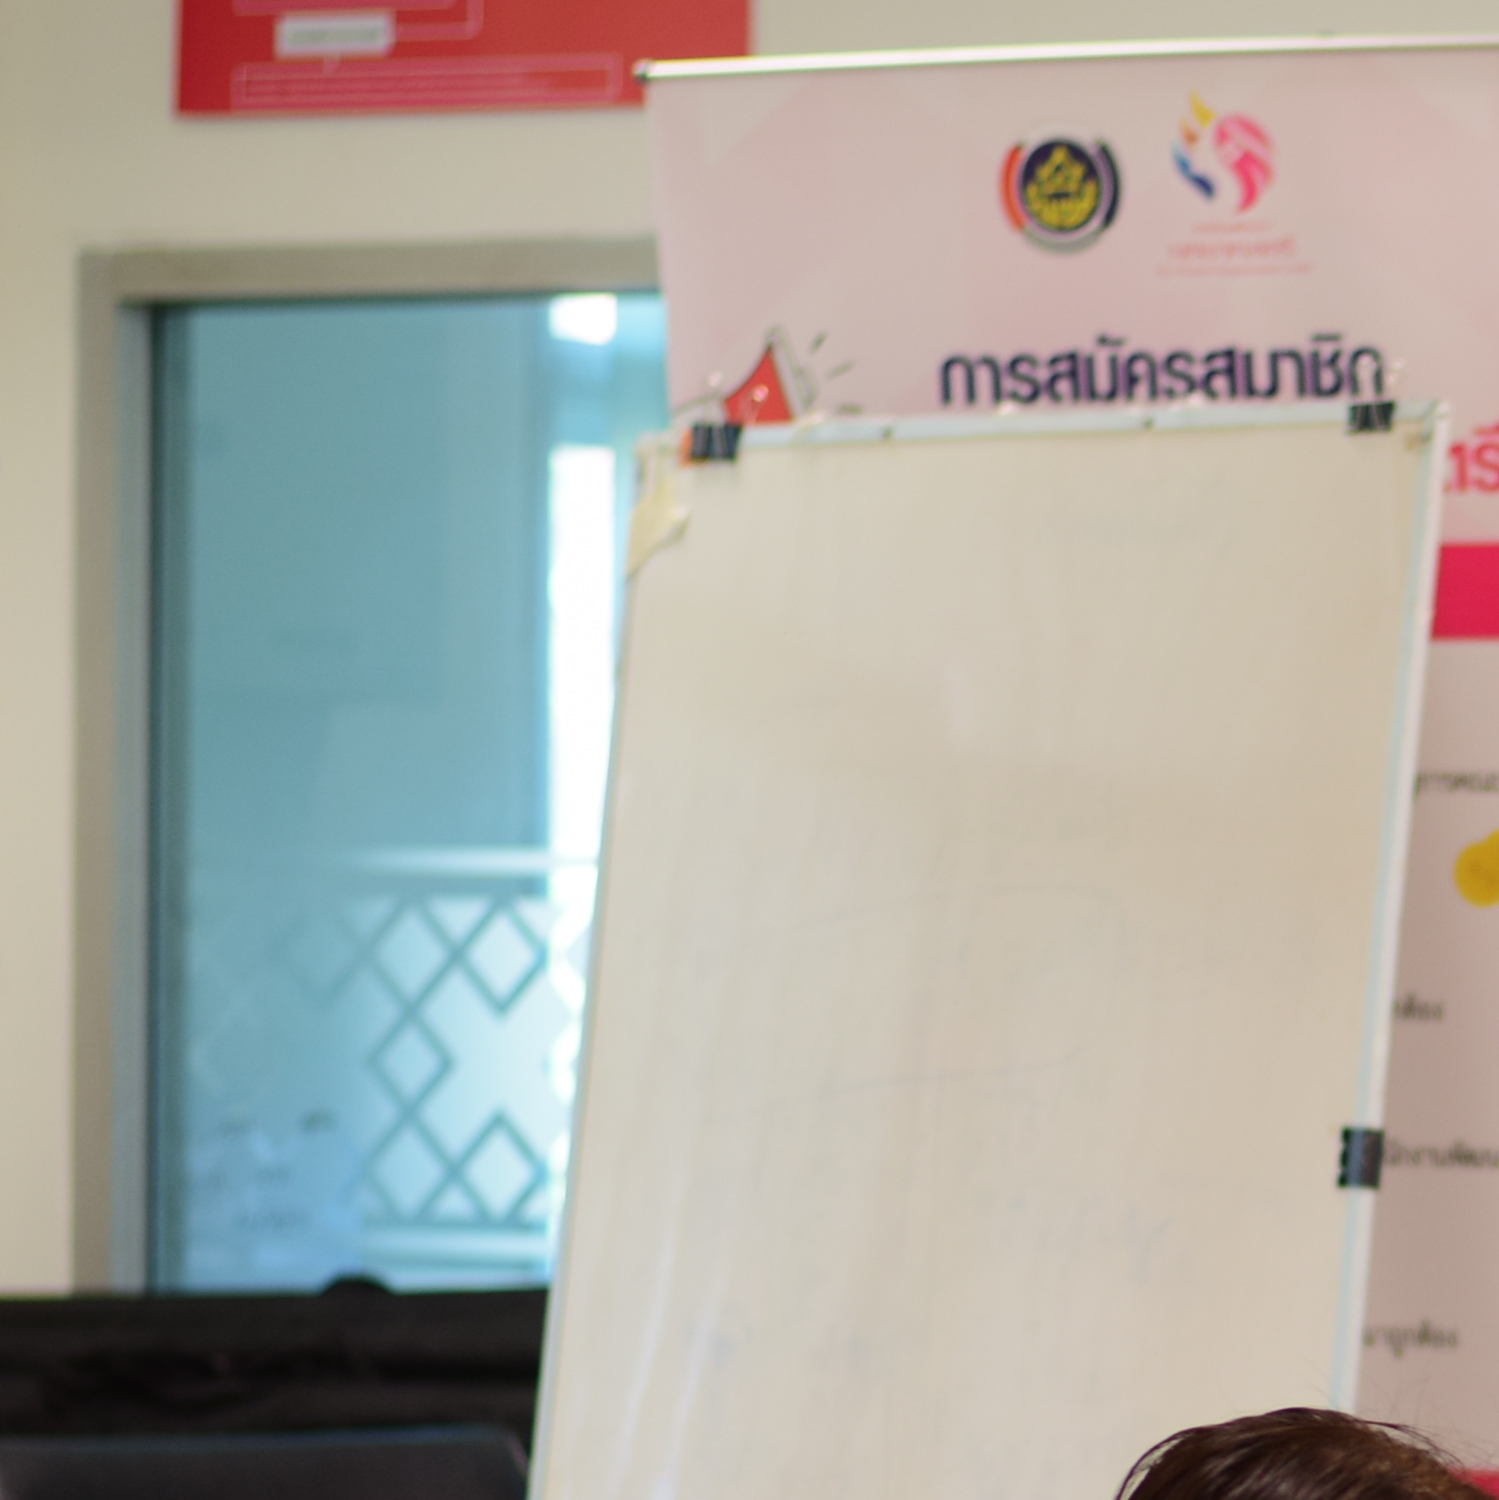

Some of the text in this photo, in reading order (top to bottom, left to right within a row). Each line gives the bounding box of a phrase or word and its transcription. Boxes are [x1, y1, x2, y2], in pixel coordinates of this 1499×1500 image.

[937, 332, 1385, 404] การสมัครสมาชิก
